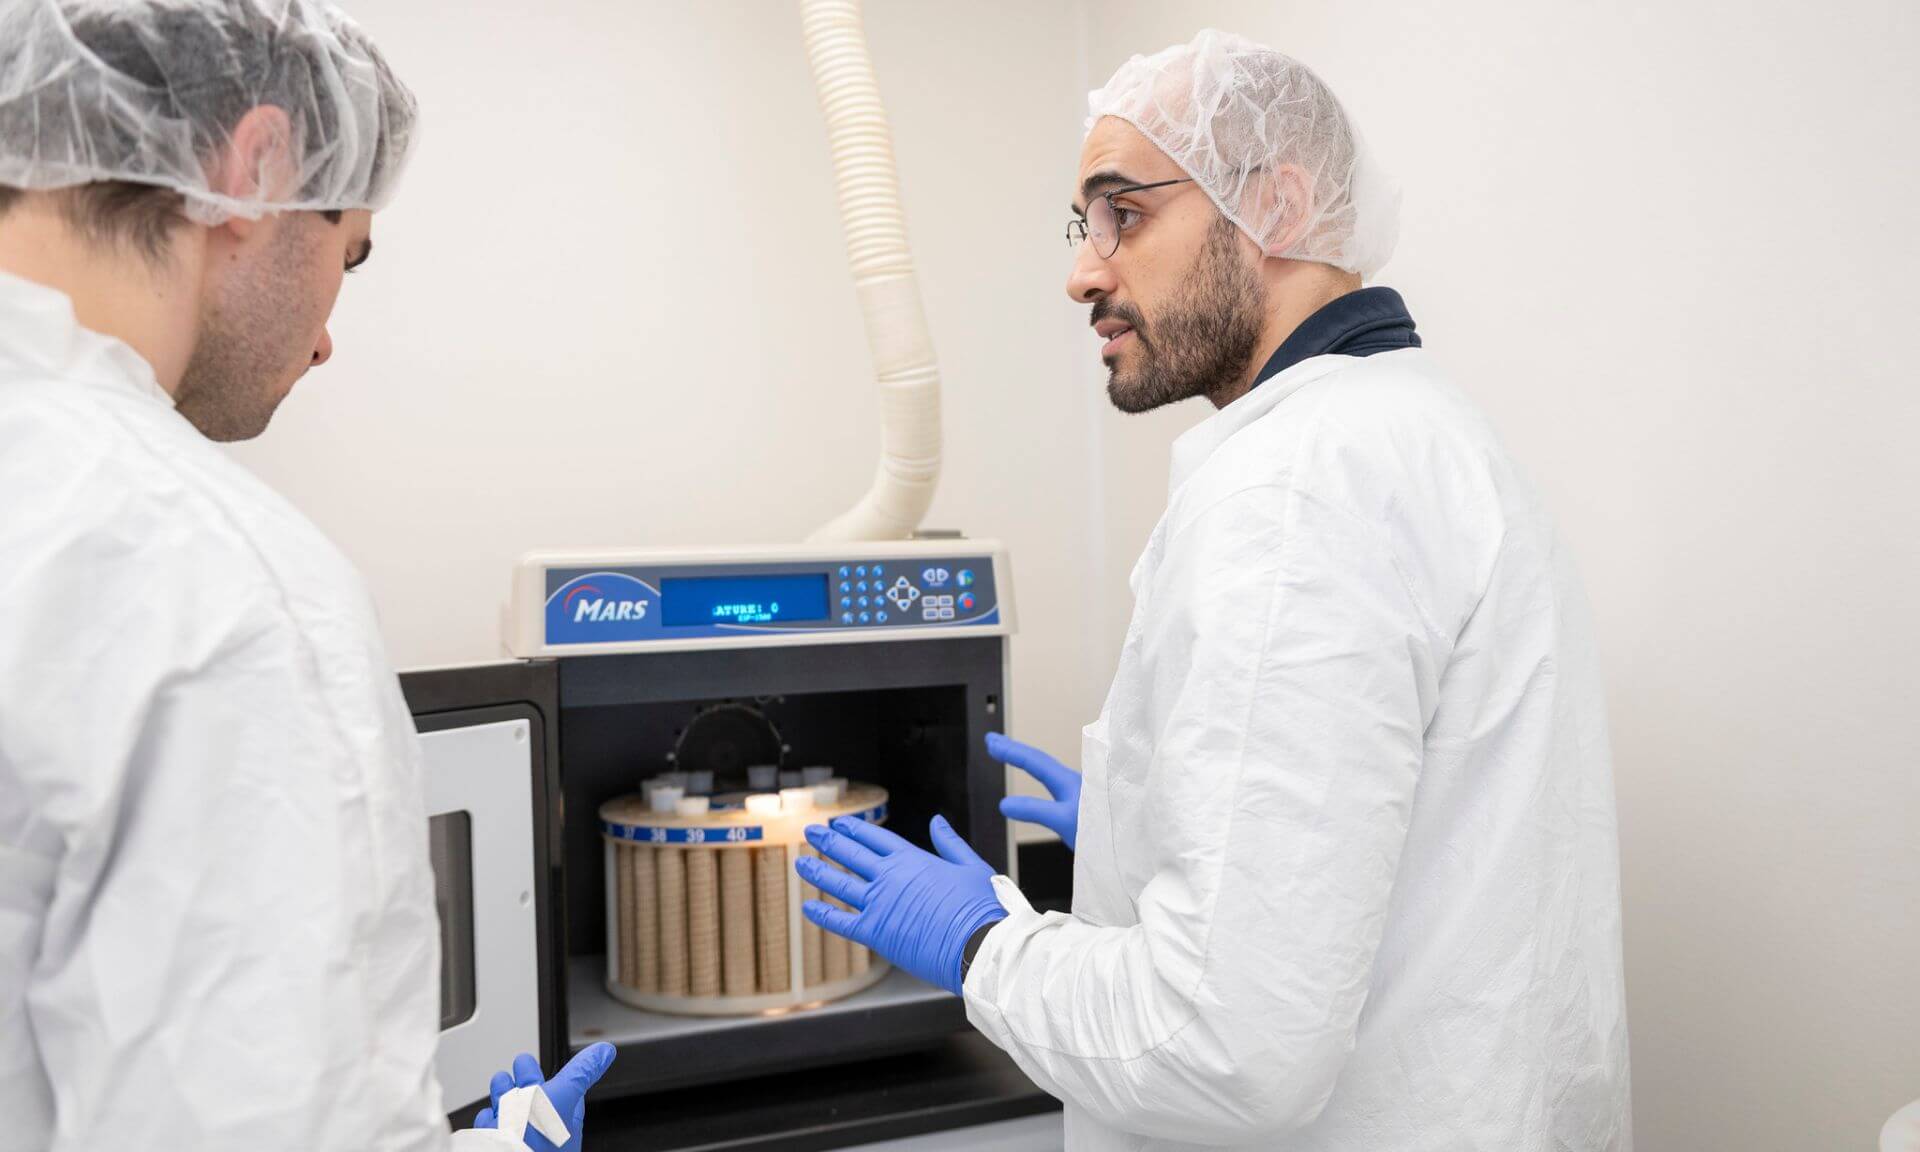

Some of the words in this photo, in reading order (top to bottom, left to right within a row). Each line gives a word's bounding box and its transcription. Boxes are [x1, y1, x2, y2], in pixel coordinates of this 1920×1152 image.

[574, 598, 648, 623] MARS
[651, 827, 667, 842] 38
[686, 827, 705, 842] 39
[726, 828, 747, 842] 40
